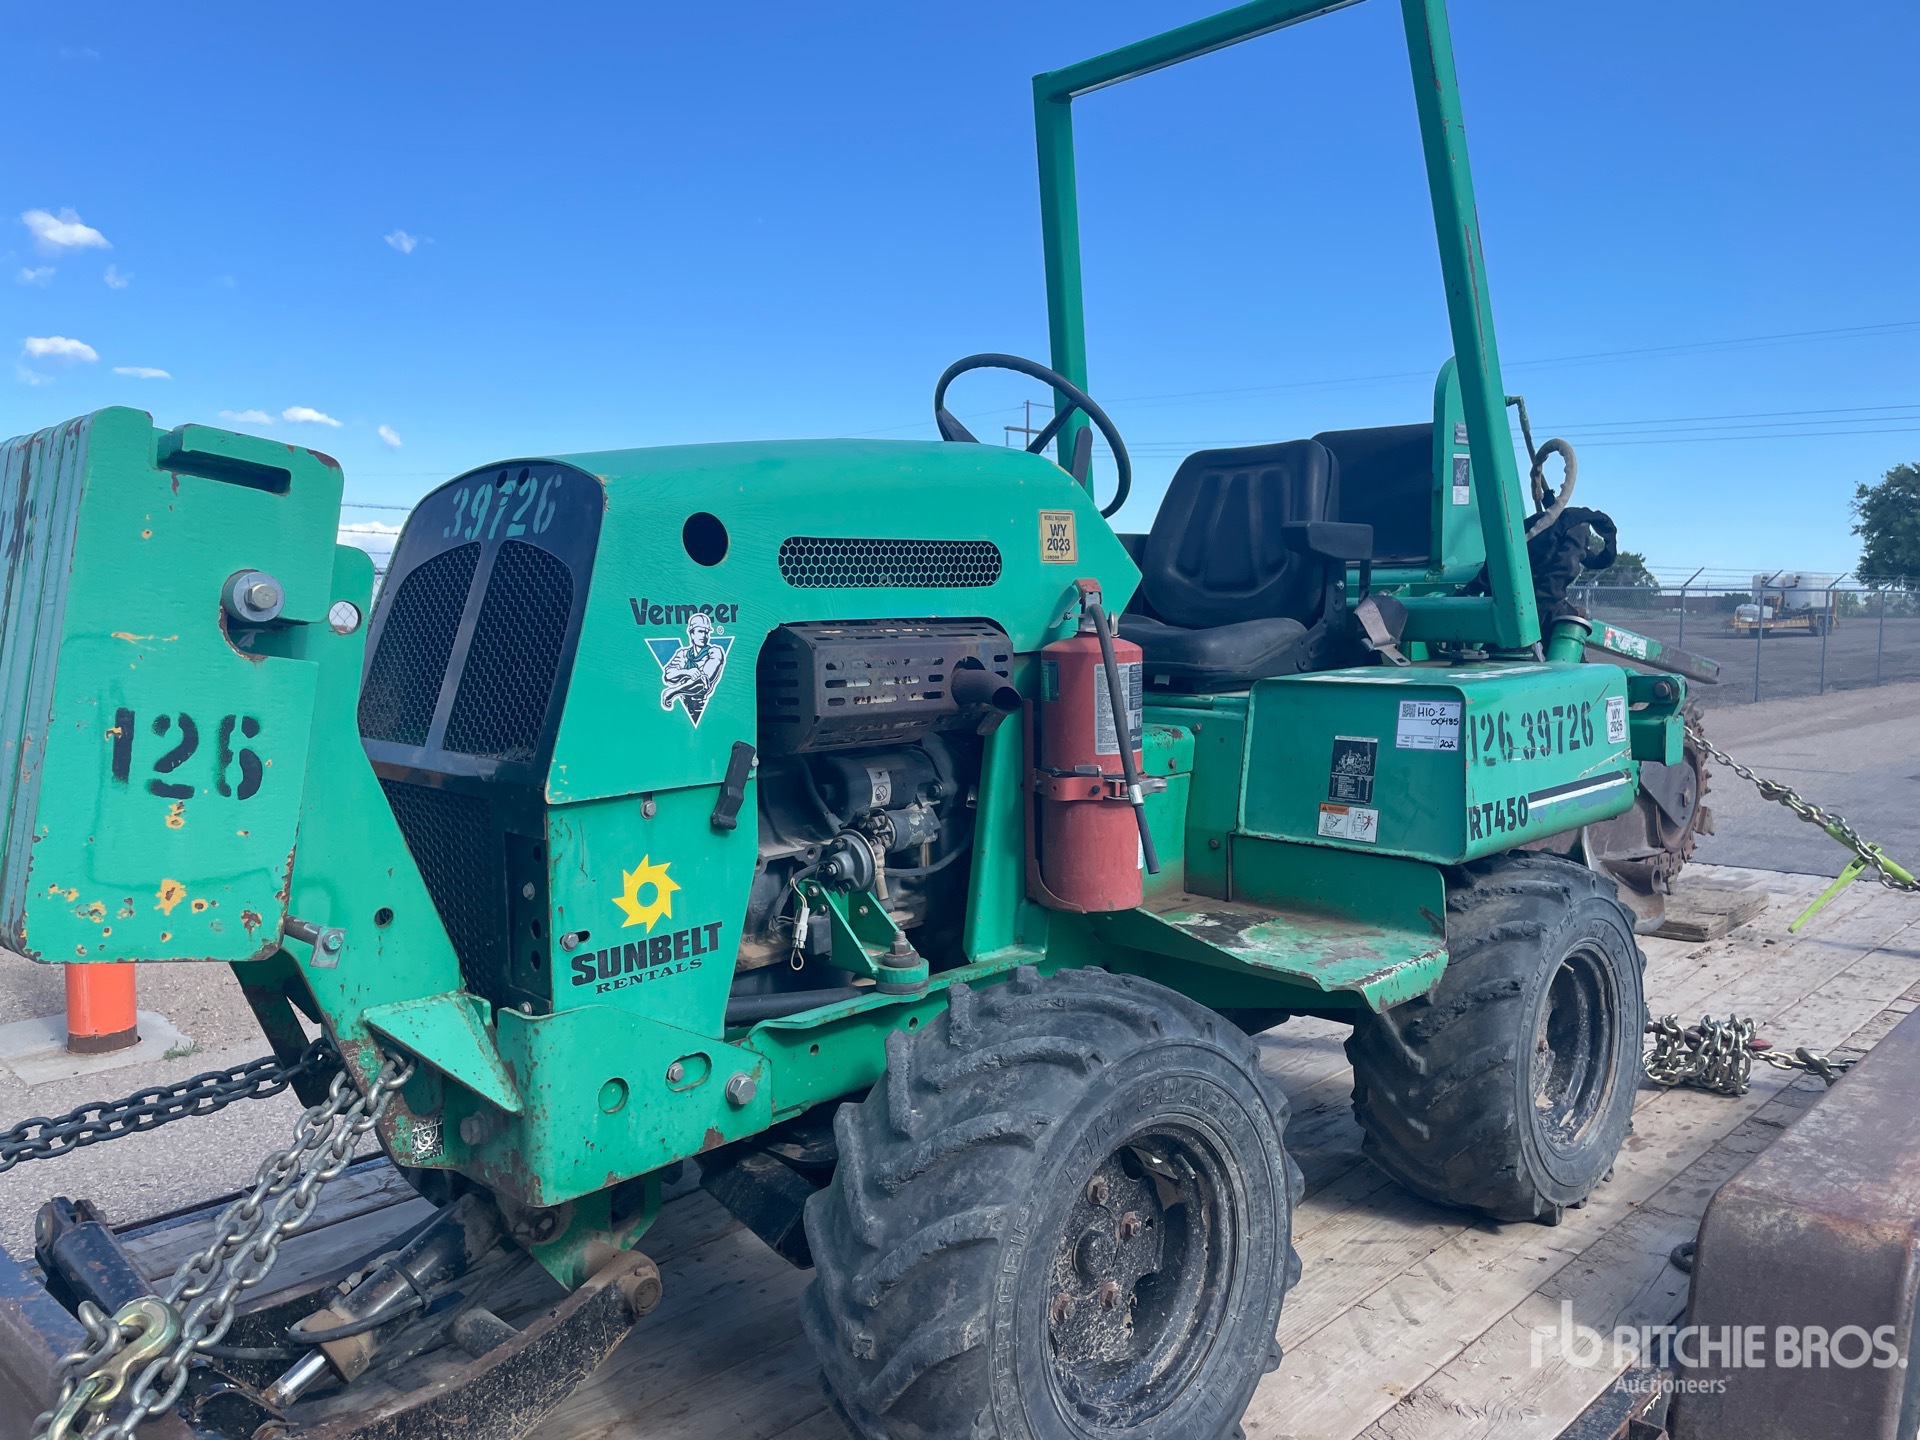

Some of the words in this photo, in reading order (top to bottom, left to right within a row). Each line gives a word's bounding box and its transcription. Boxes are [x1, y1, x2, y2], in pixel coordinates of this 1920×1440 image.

[443, 474, 562, 541] 39726
[1050, 524, 1067, 537] WY
[1047, 538, 1071, 551] 2023
[629, 598, 739, 625] Vermeer
[110, 706, 263, 801] 126
[1520, 701, 1594, 760] 39726
[1468, 795, 1529, 841] RT450
[571, 921, 723, 986] SUNBELT
[596, 958, 703, 994] RENTALS
